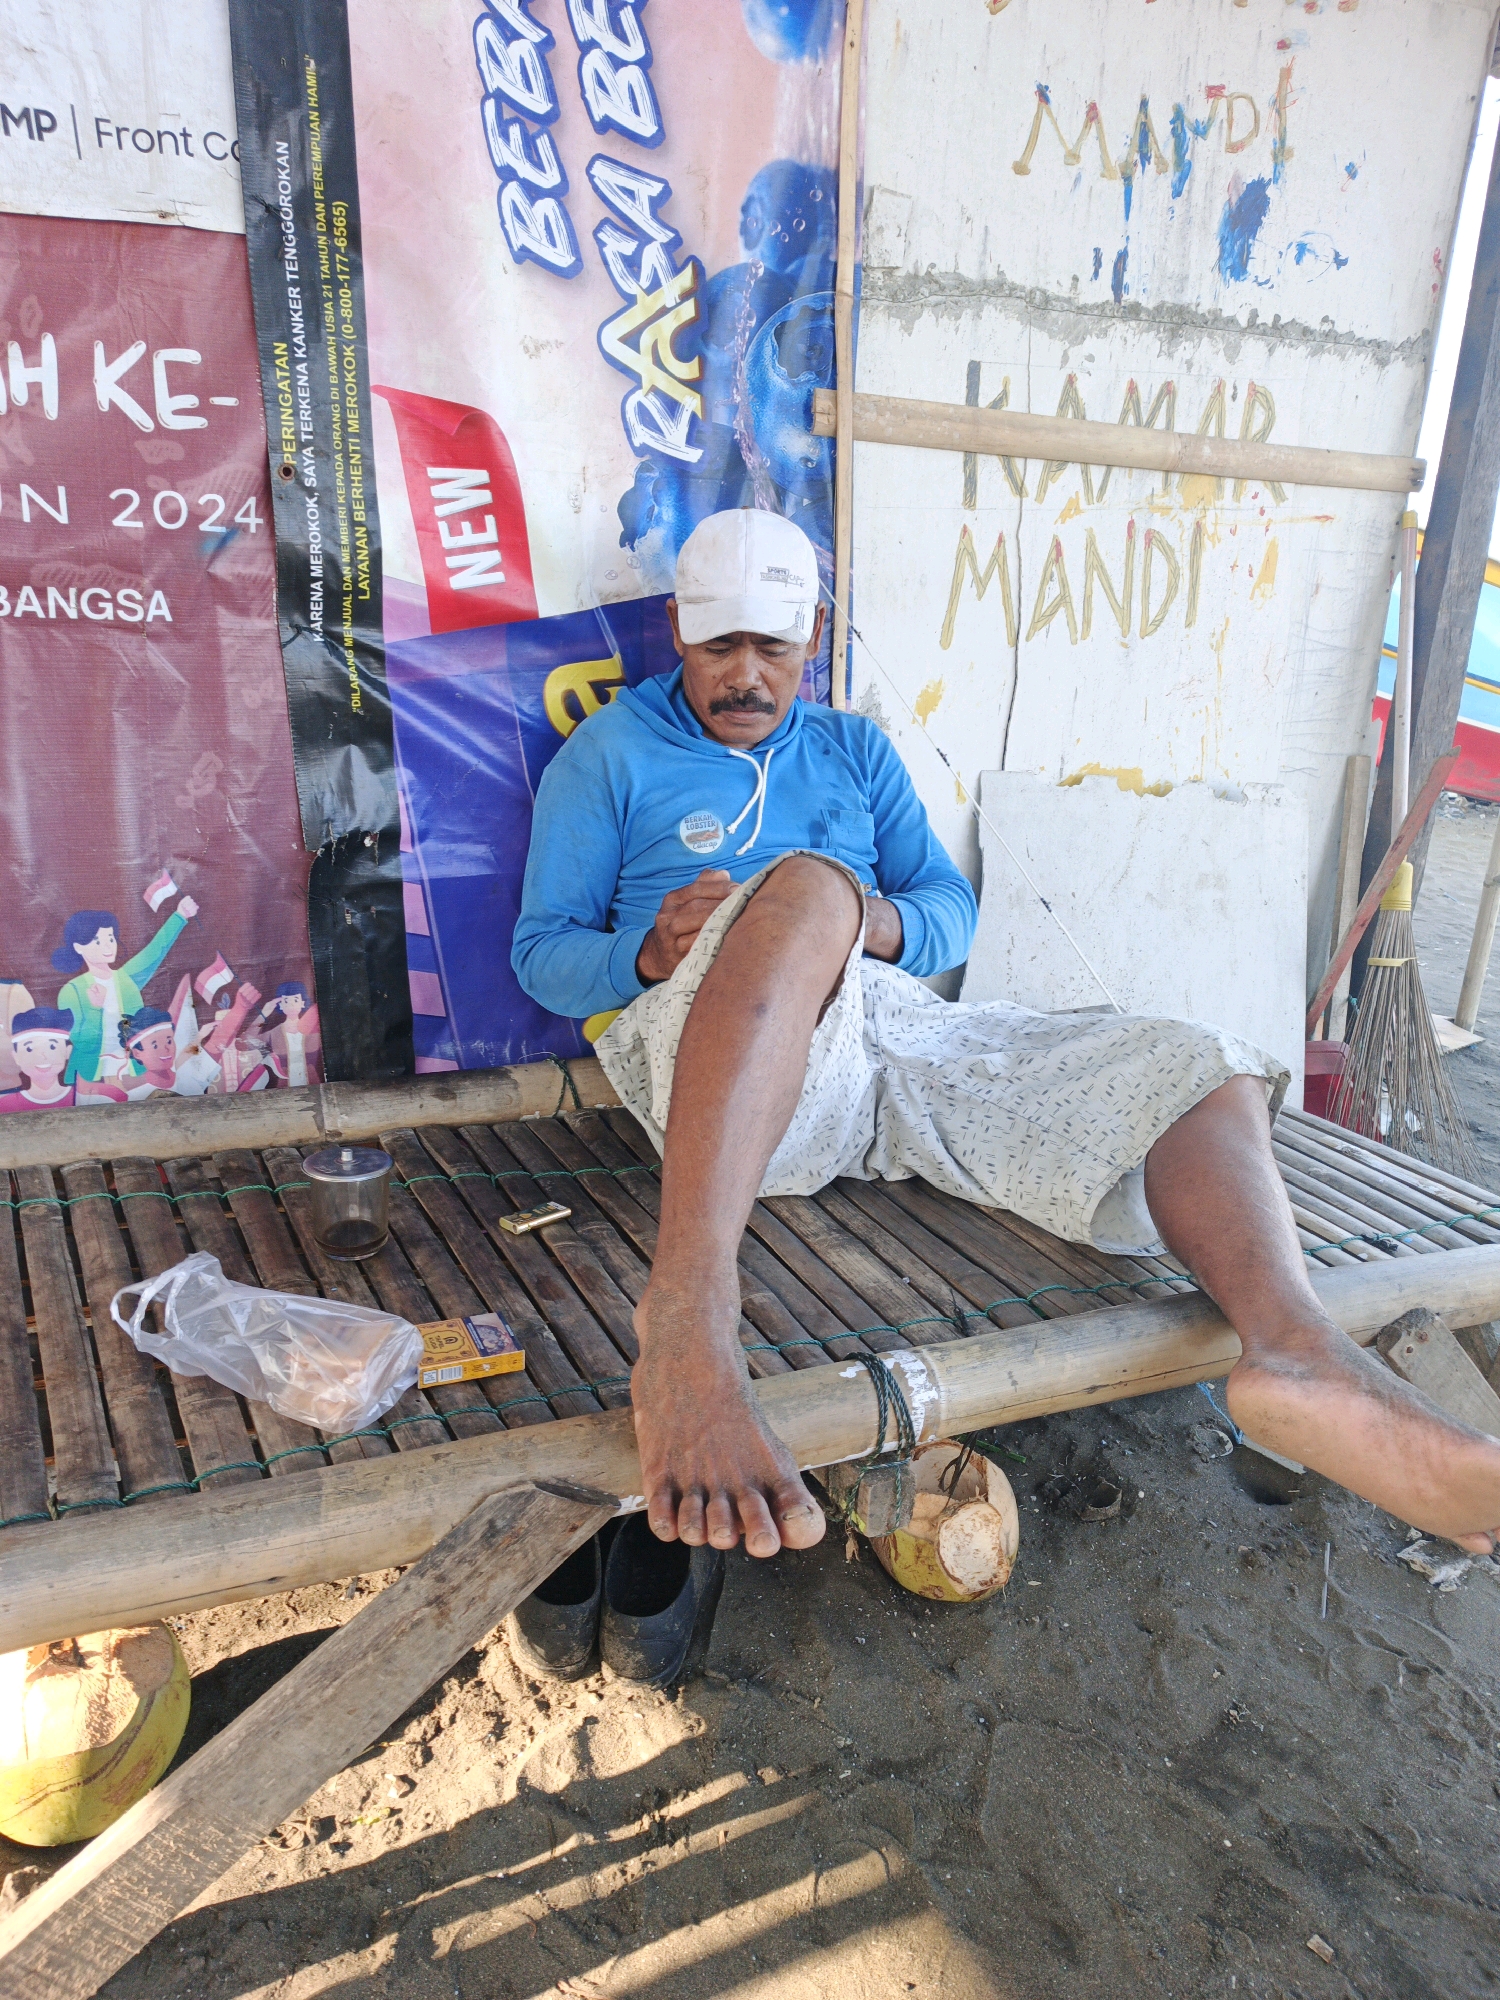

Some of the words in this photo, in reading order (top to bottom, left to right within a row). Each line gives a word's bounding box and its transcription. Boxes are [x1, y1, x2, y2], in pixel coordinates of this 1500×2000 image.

[568, 0, 659, 138] BE
[94, 117, 195, 158] Front
[308, 110, 325, 200] PEREMPUAN
[276, 141, 299, 282] TENGGOROKAN
[315, 202, 327, 232] DAN
[317, 235, 331, 280] TAHUN
[332, 201, 357, 339] (0-800-177-6565)
[322, 285, 333, 298] 21
[323, 302, 336, 333] USIA
[589, 158, 704, 463] RASA
[287, 287, 307, 358] KANKER
[0, 332, 59, 421] H
[93, 340, 240, 433] KE-
[326, 336, 338, 384] BAWAH
[343, 344, 360, 433] MEROKOK
[273, 342, 297, 465] PERINGATAN
[296, 362, 314, 442] TERKENA
[330, 387, 340, 400] DI
[331, 403, 343, 450] ORANG
[962, 360, 1288, 511] KAMAR
[302, 446, 317, 487] SAYA
[333, 453, 346, 504] KEPADA
[349, 438, 366, 521] BERHENTI
[108, 488, 264, 534] 2024
[305, 493, 323, 578] MEROKOK,
[338, 506, 350, 564] MEMBERI
[427, 465, 507, 591] NEW
[342, 568, 353, 593] DAN
[355, 526, 371, 600] LAYANAN
[938, 519, 1203, 651] MANDI
[310, 581, 325, 642] KARENA
[342, 594, 353, 647] MENJUAL
[684, 814, 713, 824] BERKAH
[686, 820, 716, 830] LOBSTER
